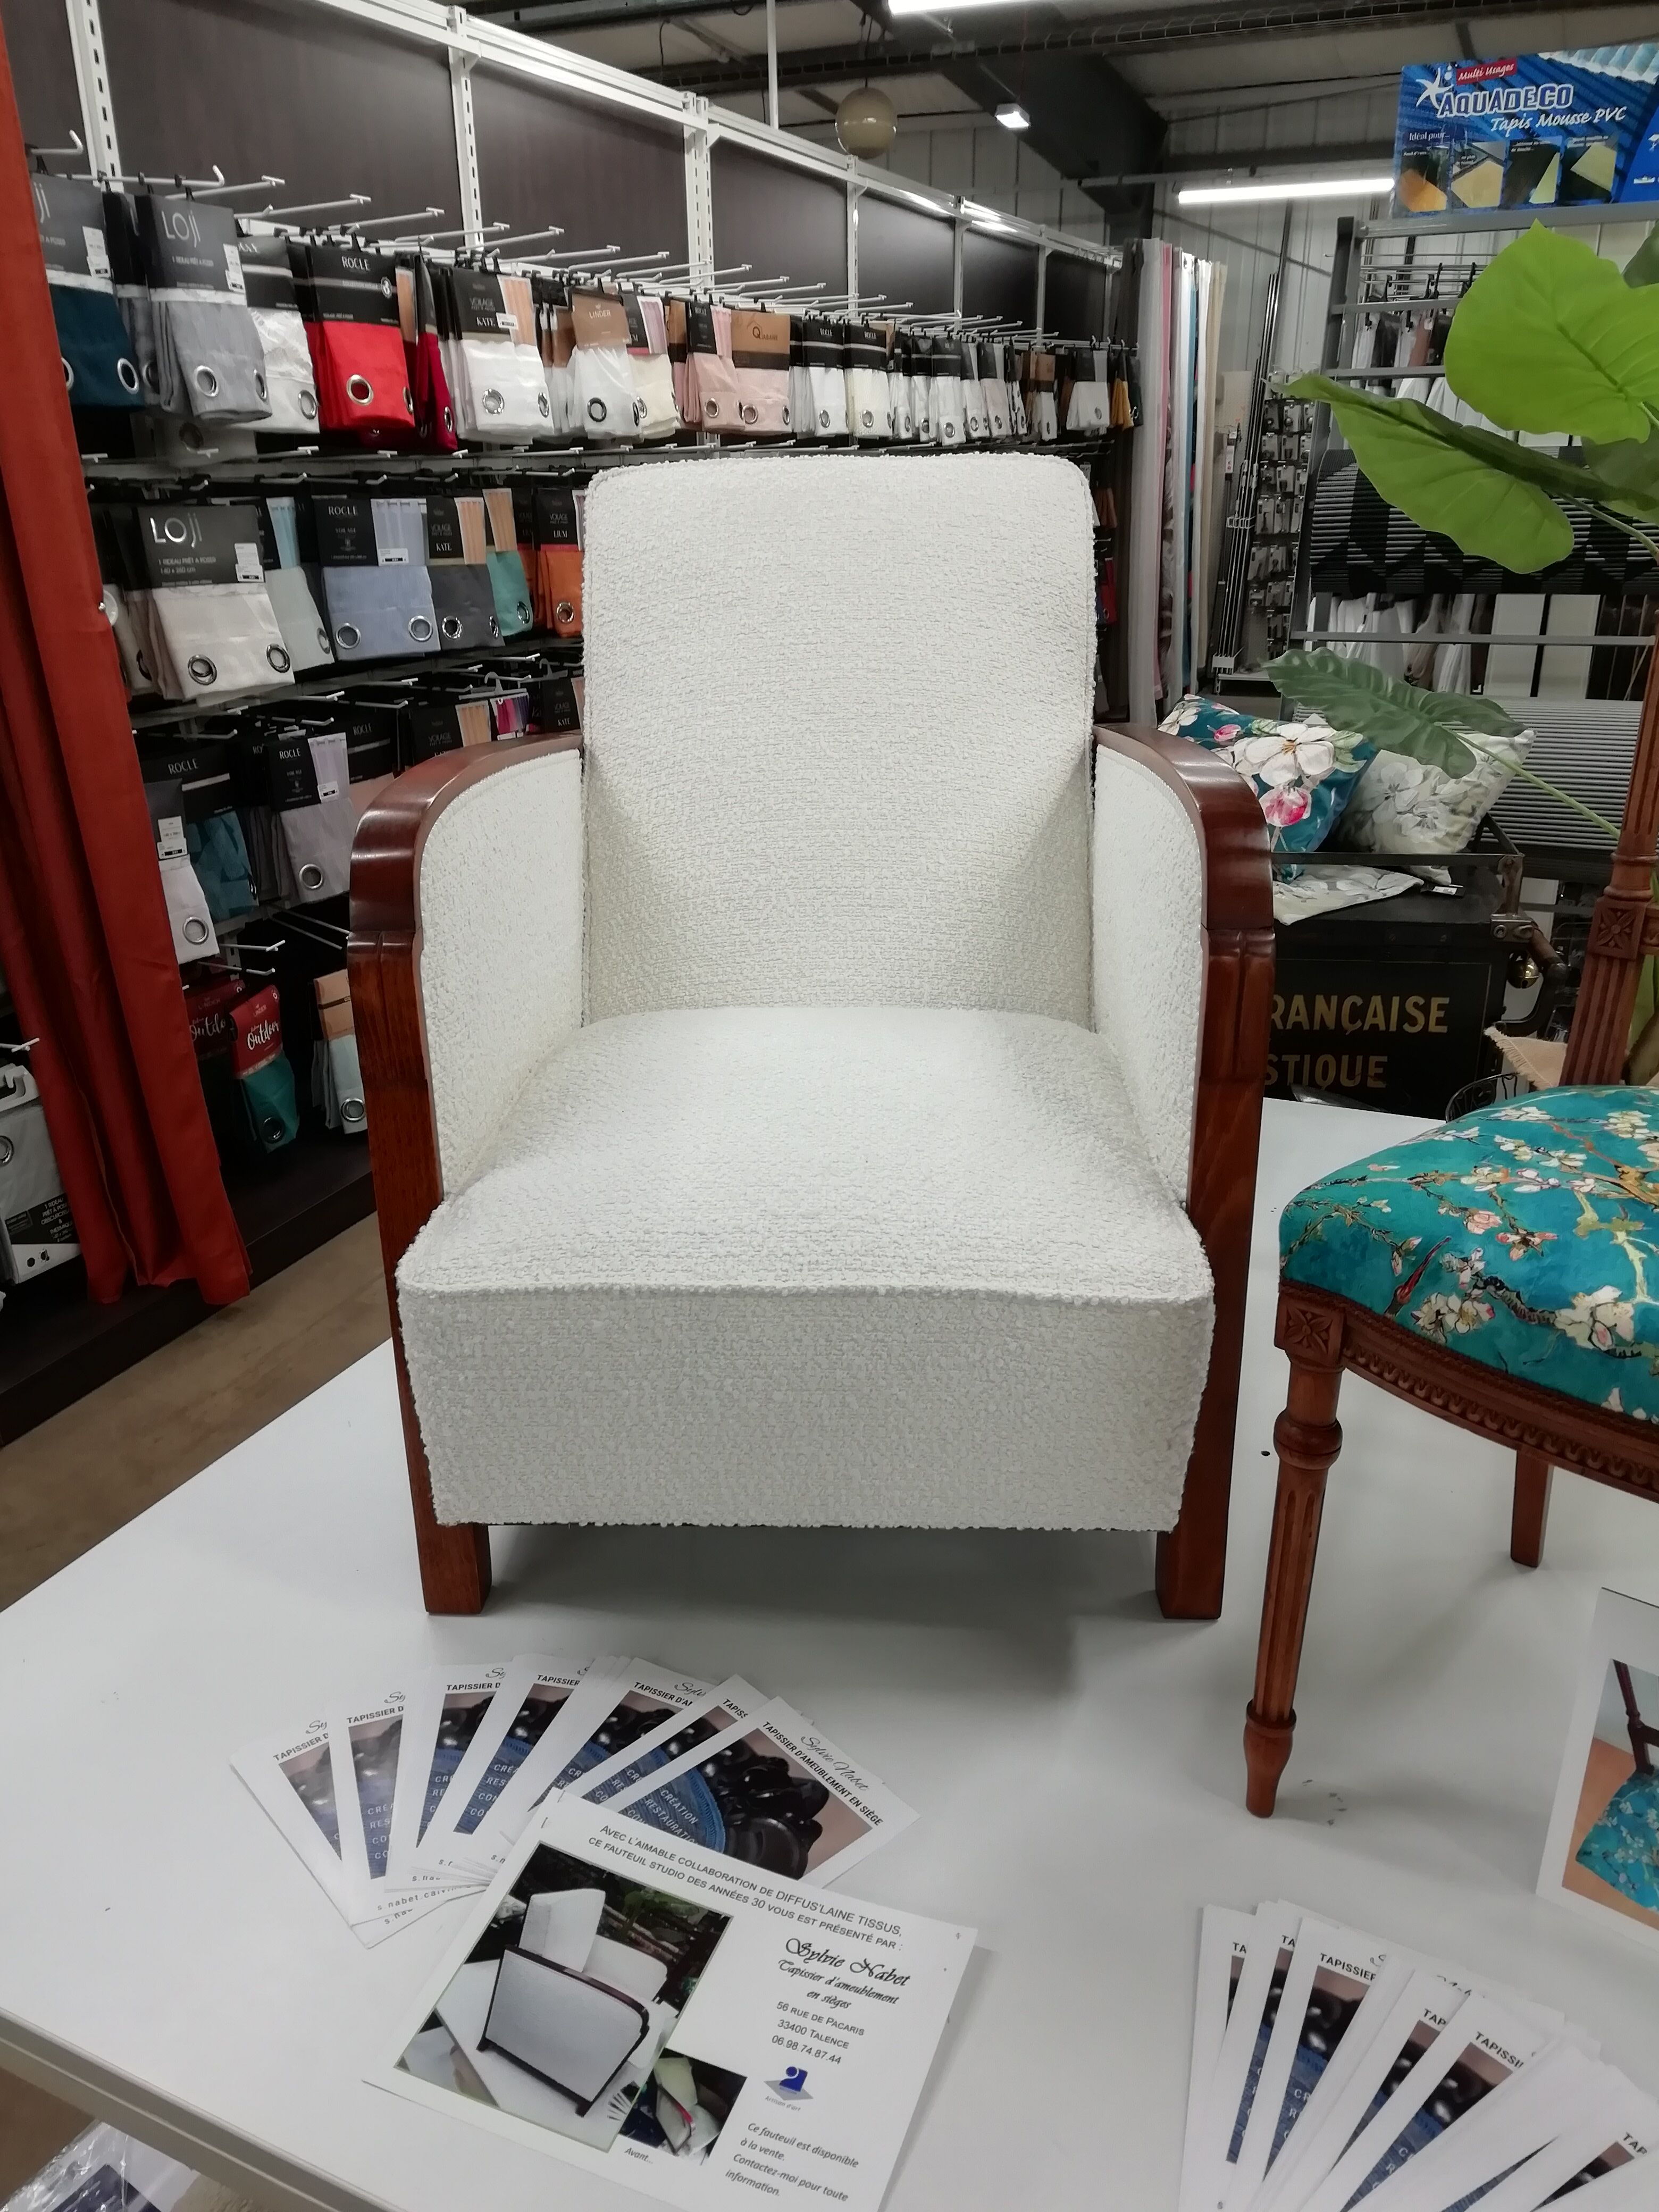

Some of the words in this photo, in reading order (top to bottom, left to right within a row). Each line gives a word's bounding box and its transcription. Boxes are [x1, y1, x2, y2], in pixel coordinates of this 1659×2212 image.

[1458, 69, 1484, 82] Multi
[1485, 62, 1514, 79] Usages
[1436, 83, 1574, 118] AQUADECO
[1490, 113, 1533, 138] Tapis
[1535, 110, 1592, 128] Mousse
[1593, 106, 1627, 123] PVC
[588, 309, 611, 319] LINDER
[435, 542, 452, 552] KATE
[167, 758, 199, 775] ROCLE
[279, 748, 301, 760] ROCLE
[247, 1019, 280, 1051] Outdoor
[446, 1682, 493, 1691] TAPISSIER
[633, 1681, 675, 1702] TAPISSIER
[346, 1707, 396, 1724] TAPISSIER
[273, 1733, 323, 1762] TAPISSIER
[763, 1721, 798, 1753] TAPISSIER
[794, 1750, 852, 1801] D'AMEUBLEMENT
[849, 1796, 863, 1808] EN
[859, 1806, 884, 1826] SIÈGE
[800, 1736, 834, 1763] Sylvie
[833, 1761, 869, 1791] Nabet
[660, 1789, 699, 1825] CRÉATION
[588, 1837, 602, 1848] CE
[604, 1842, 647, 1866] FAUTEUIL
[649, 1861, 685, 1881] STUDIO
[686, 1875, 708, 1889] DES
[708, 1884, 750, 1904] ANNÉES
[751, 1897, 766, 1910] 30
[767, 1904, 796, 1920] VOUS
[797, 1914, 818, 1927] EST
[818, 1921, 873, 1943] PRÉSENTÉ
[875, 1938, 897, 1950] PAR
[600, 1825, 626, 1843] AVEC
[627, 1836, 677, 1862] L'AIMABLE
[678, 1856, 758, 1892] COLLABORATION
[759, 1886, 775, 1898] DE
[775, 1889, 856, 1923] DIFFUS'LAINE
[858, 1914, 903, 1937] TISSUS,
[785, 1937, 845, 1968] Sylvie
[849, 1958, 911, 1987] Nabet
[777, 1959, 825, 1982] Tapissier
[825, 1976, 900, 2005] d'ameublement
[806, 1990, 820, 2000] en
[820, 1994, 852, 2010] sièges
[776, 2000, 790, 2012] 56
[790, 2006, 810, 2019] RUE
[810, 2013, 825, 2024] DE
[825, 2016, 865, 2037] PACARIS
[777, 2019, 808, 2035] 33400
[810, 2029, 850, 2049] TALENCE
[771, 2034, 842, 2065] 06.98.74.87.44
[740, 2138, 748, 2147] à
[748, 2140, 759, 2151] la
[759, 2146, 786, 2161] vente.
[747, 2122, 760, 2133] Ce
[759, 2126, 797, 2148] fauteuil
[796, 2139, 812, 2152] est
[811, 2144, 859, 2168] disponible
[725, 2168, 781, 2197] information.
[733, 2153, 798, 2184] Contactez-moi
[798, 2177, 822, 2193] pour
[822, 2186, 850, 2203] toute
